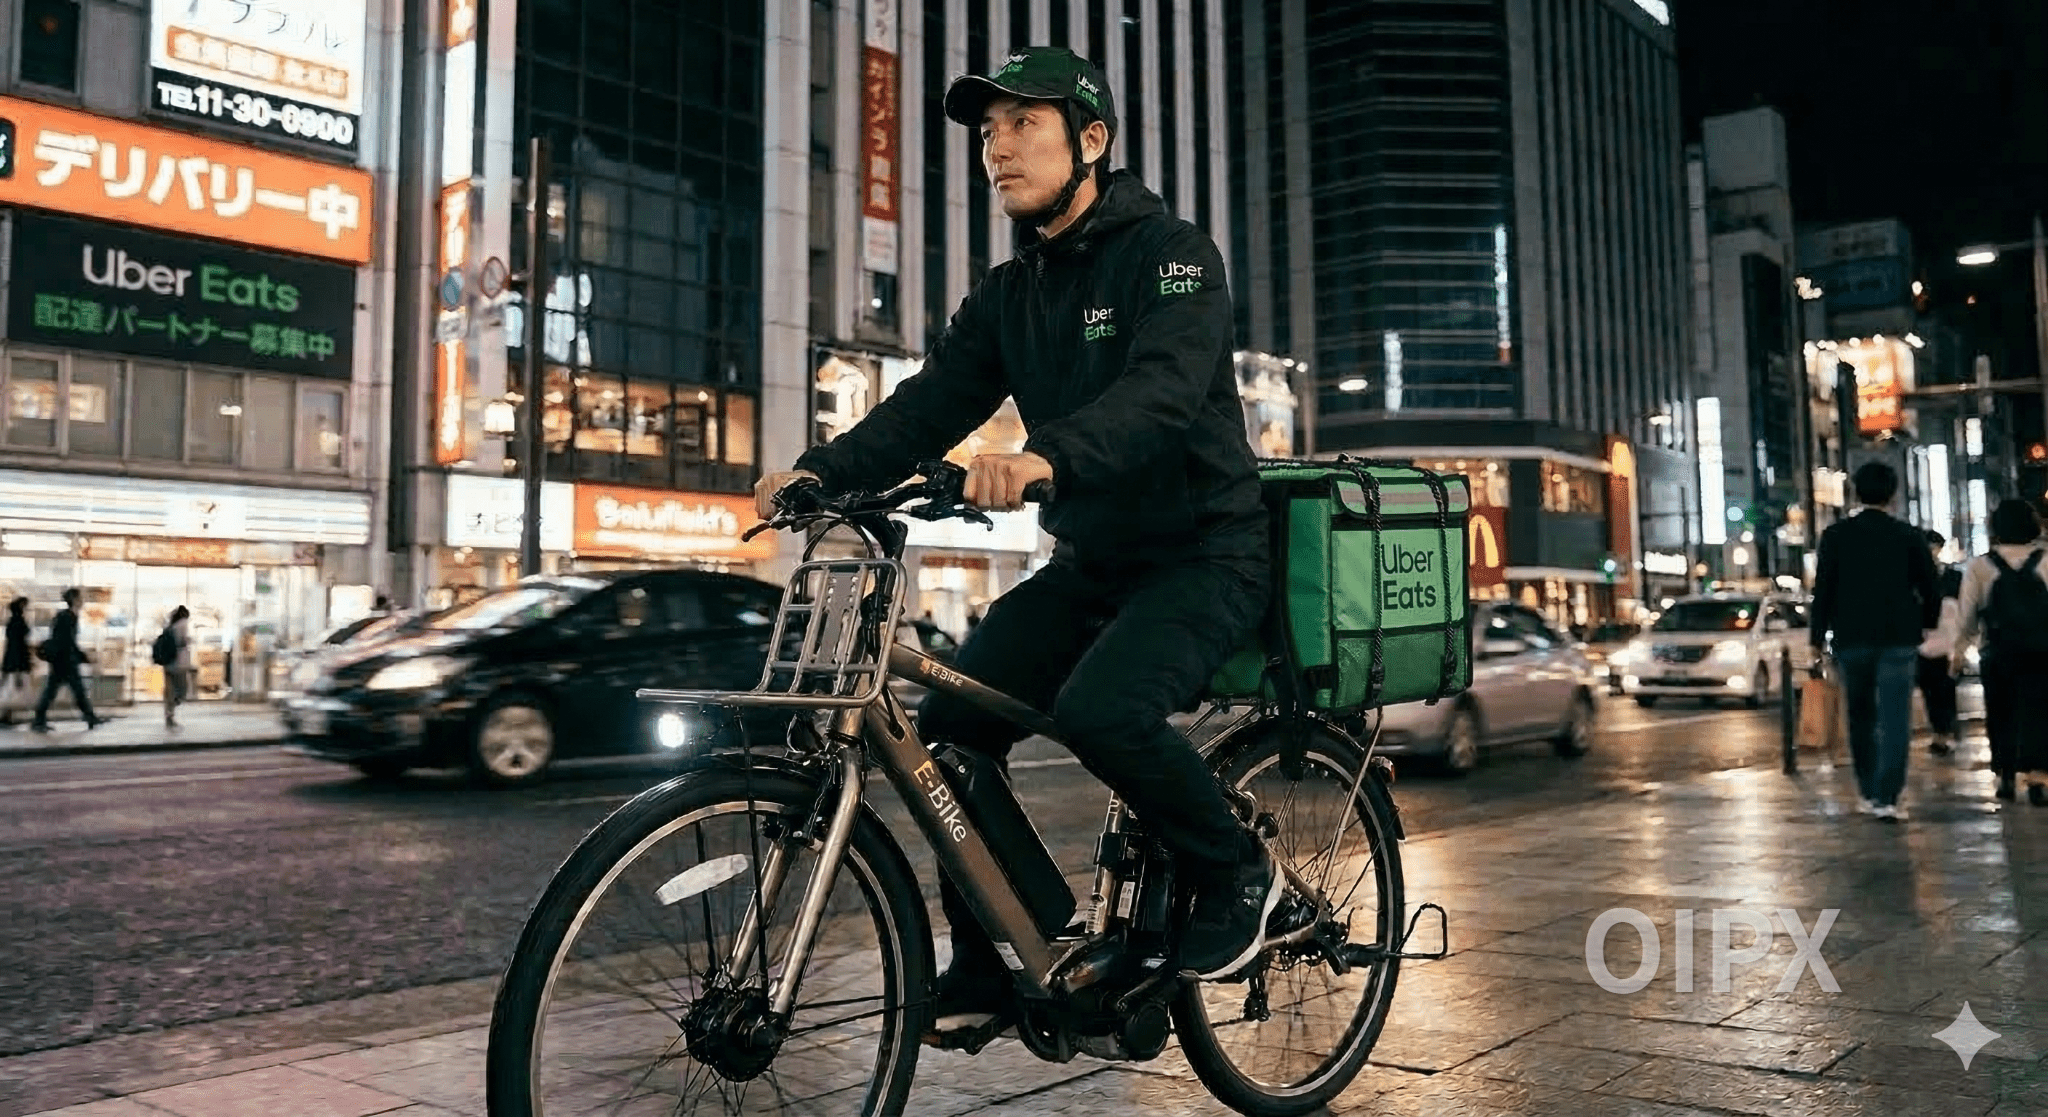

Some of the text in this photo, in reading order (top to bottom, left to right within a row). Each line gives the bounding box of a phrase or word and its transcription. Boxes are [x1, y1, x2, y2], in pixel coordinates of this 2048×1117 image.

[83, 244, 301, 312] Uber Eats
[1159, 261, 1203, 278] Uber
[1084, 307, 1115, 324] Uber
[1084, 323, 1117, 341] Eats
[1381, 543, 1434, 575] Uber
[1383, 580, 1437, 610] Eats
[913, 760, 967, 843] E-Bike
